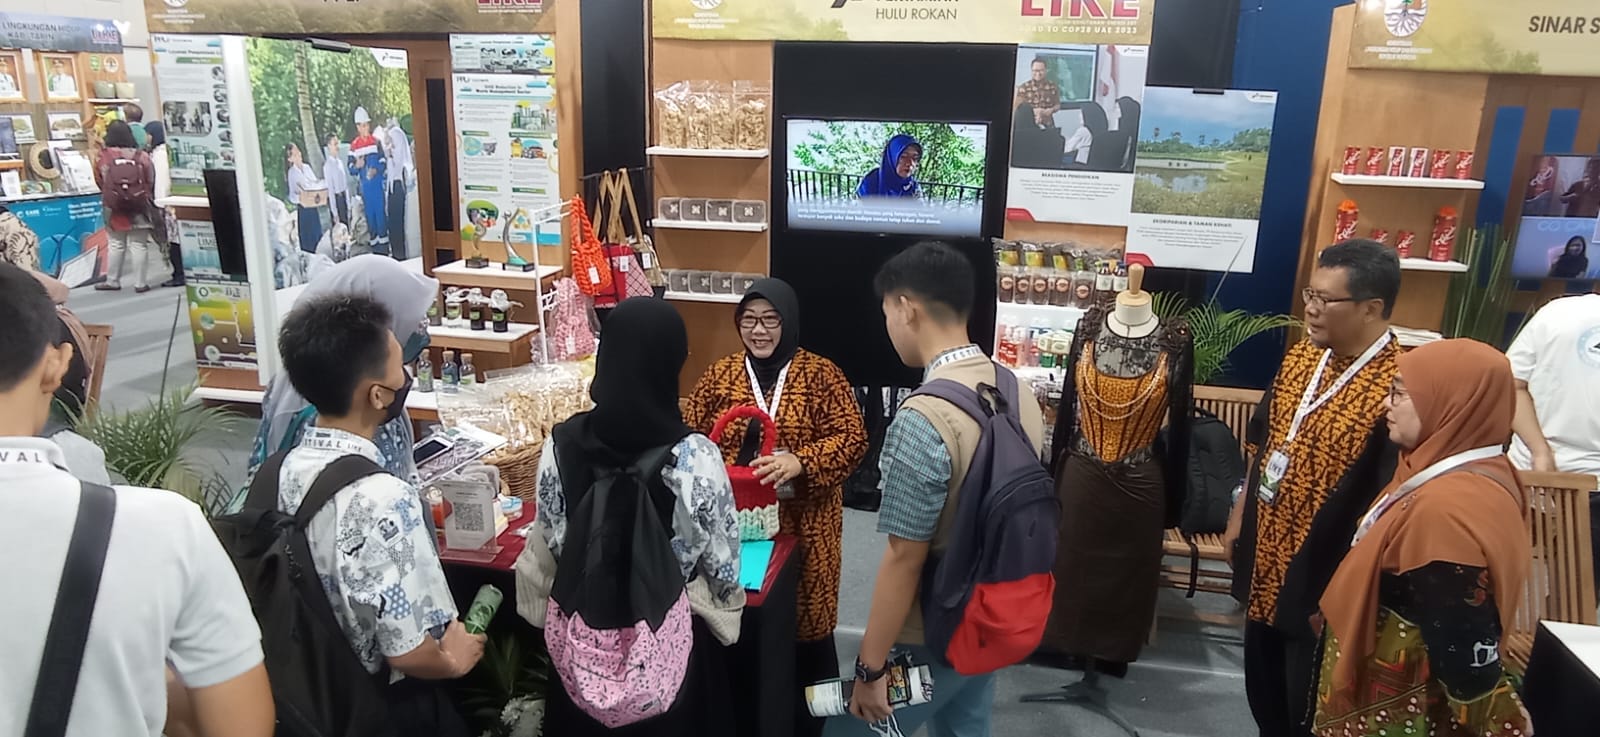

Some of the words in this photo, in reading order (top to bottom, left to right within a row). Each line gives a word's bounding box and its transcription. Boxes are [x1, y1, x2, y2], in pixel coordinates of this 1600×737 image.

[876, 8, 907, 19] HULU
[911, 8, 957, 20] ROKAN
[2, 21, 57, 31] LINGKUNGAN
[1529, 16, 1585, 34] SINAR
